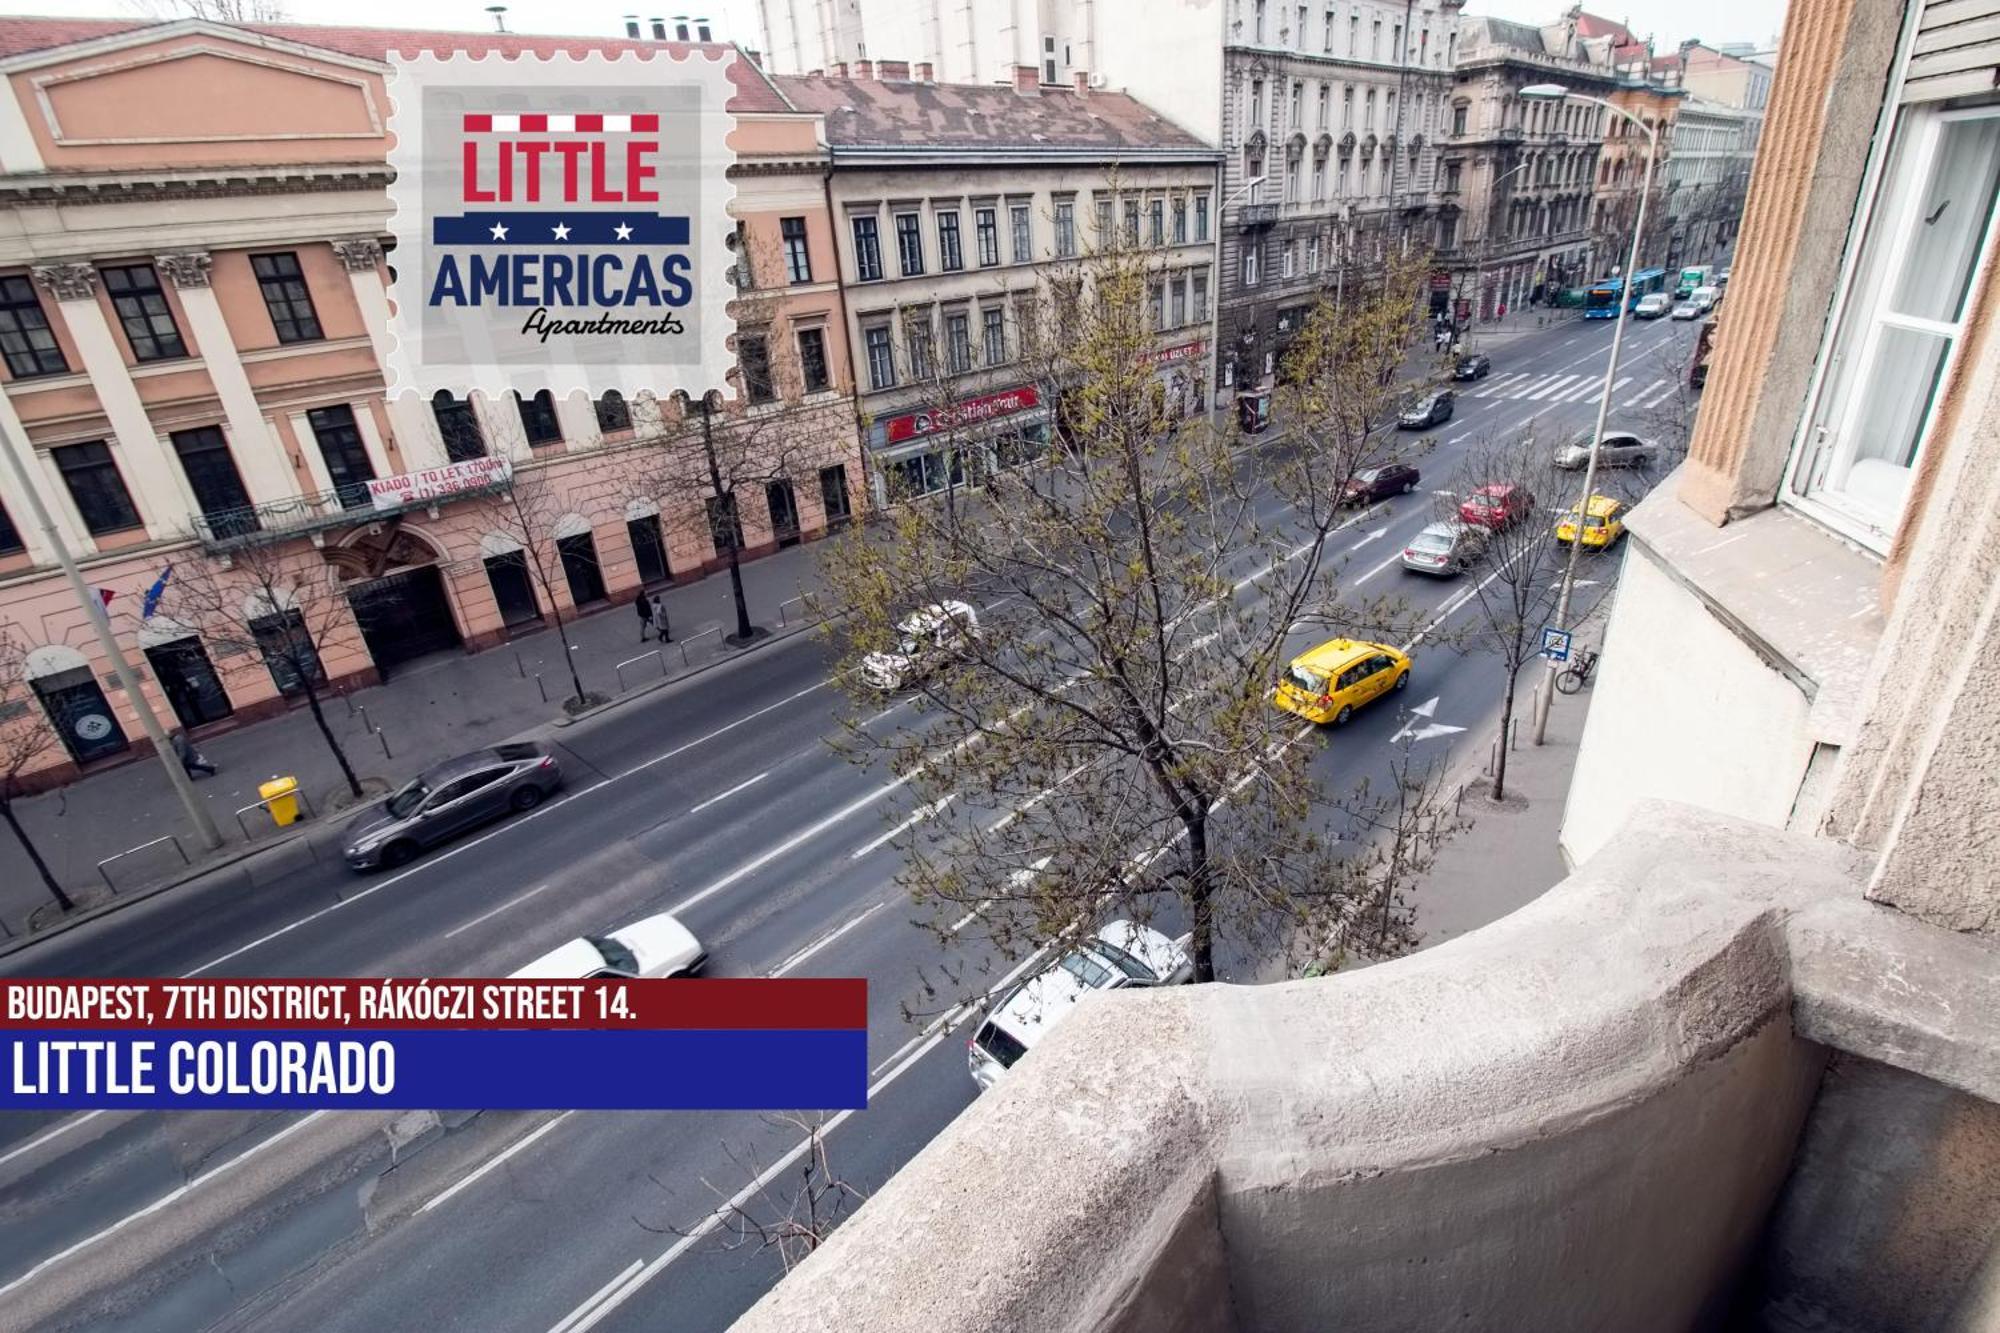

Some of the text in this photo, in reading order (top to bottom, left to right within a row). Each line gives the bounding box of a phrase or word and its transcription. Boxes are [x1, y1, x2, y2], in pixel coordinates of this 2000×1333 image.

[421, 471, 438, 484] TO
[440, 466, 461, 480] LET
[438, 480, 460, 493] 336
